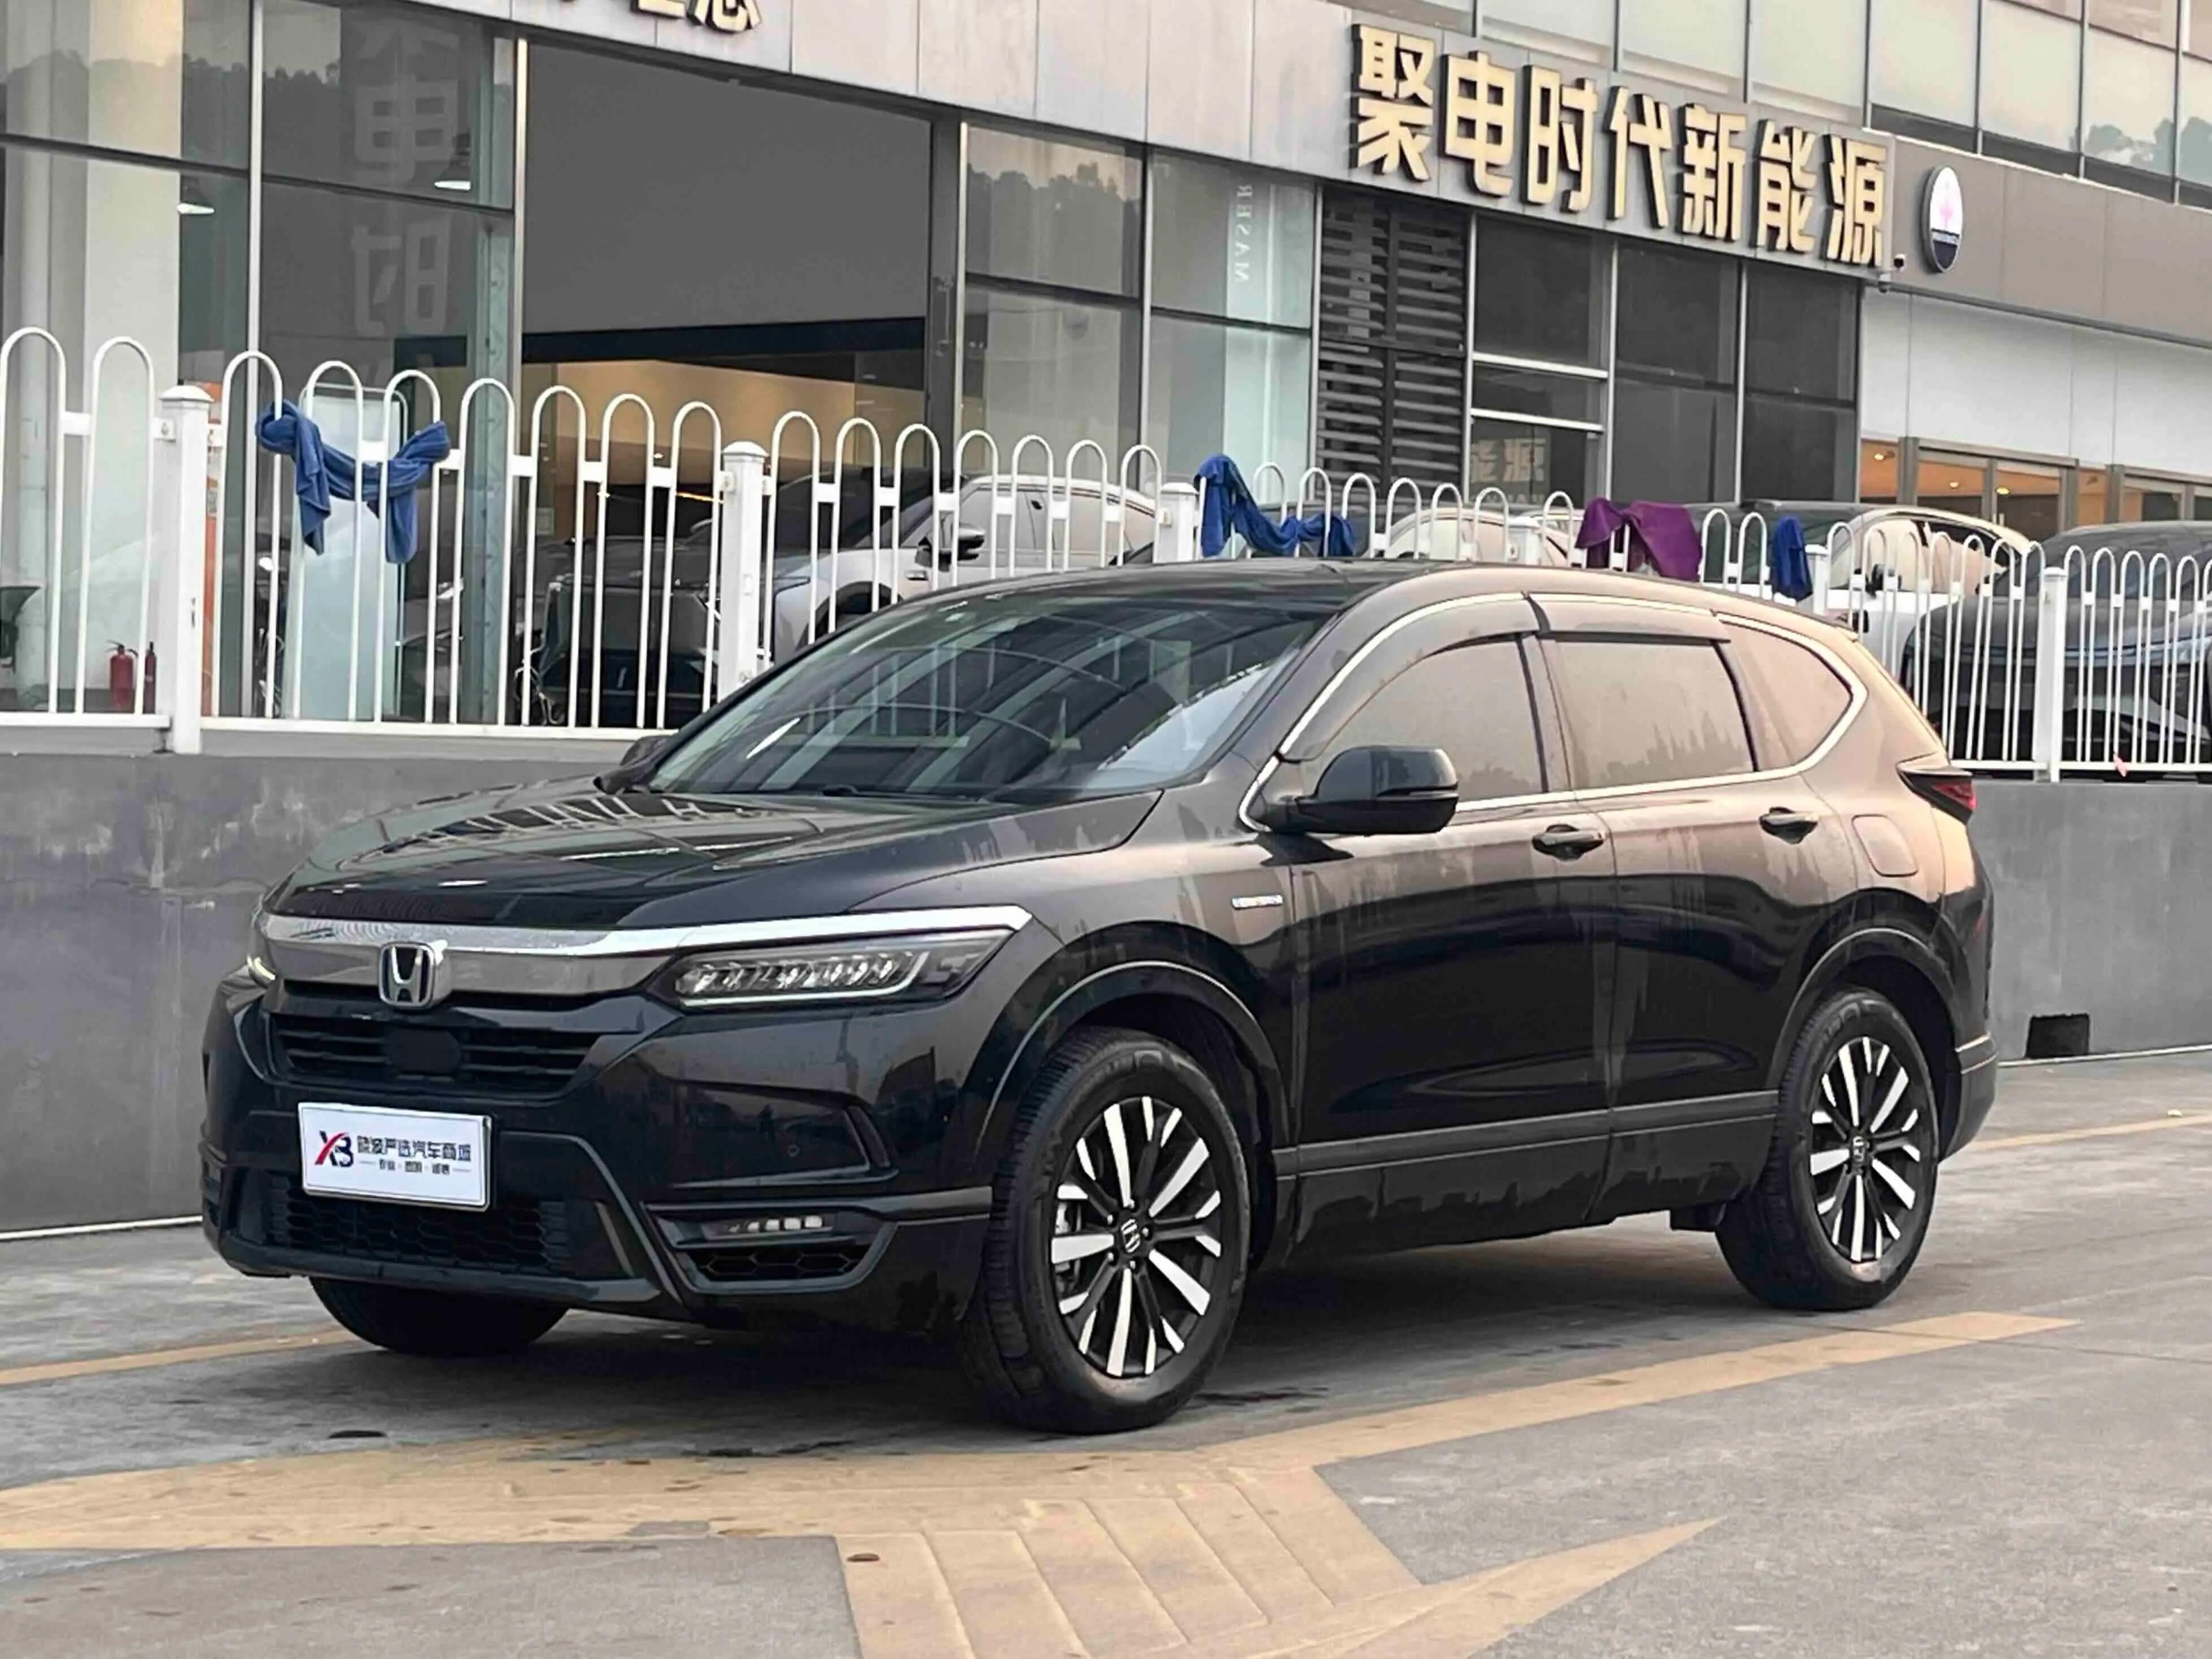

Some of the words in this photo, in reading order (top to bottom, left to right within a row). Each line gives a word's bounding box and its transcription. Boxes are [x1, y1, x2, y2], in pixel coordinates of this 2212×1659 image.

[1352, 23, 1885, 267] 聚电时代新能源
